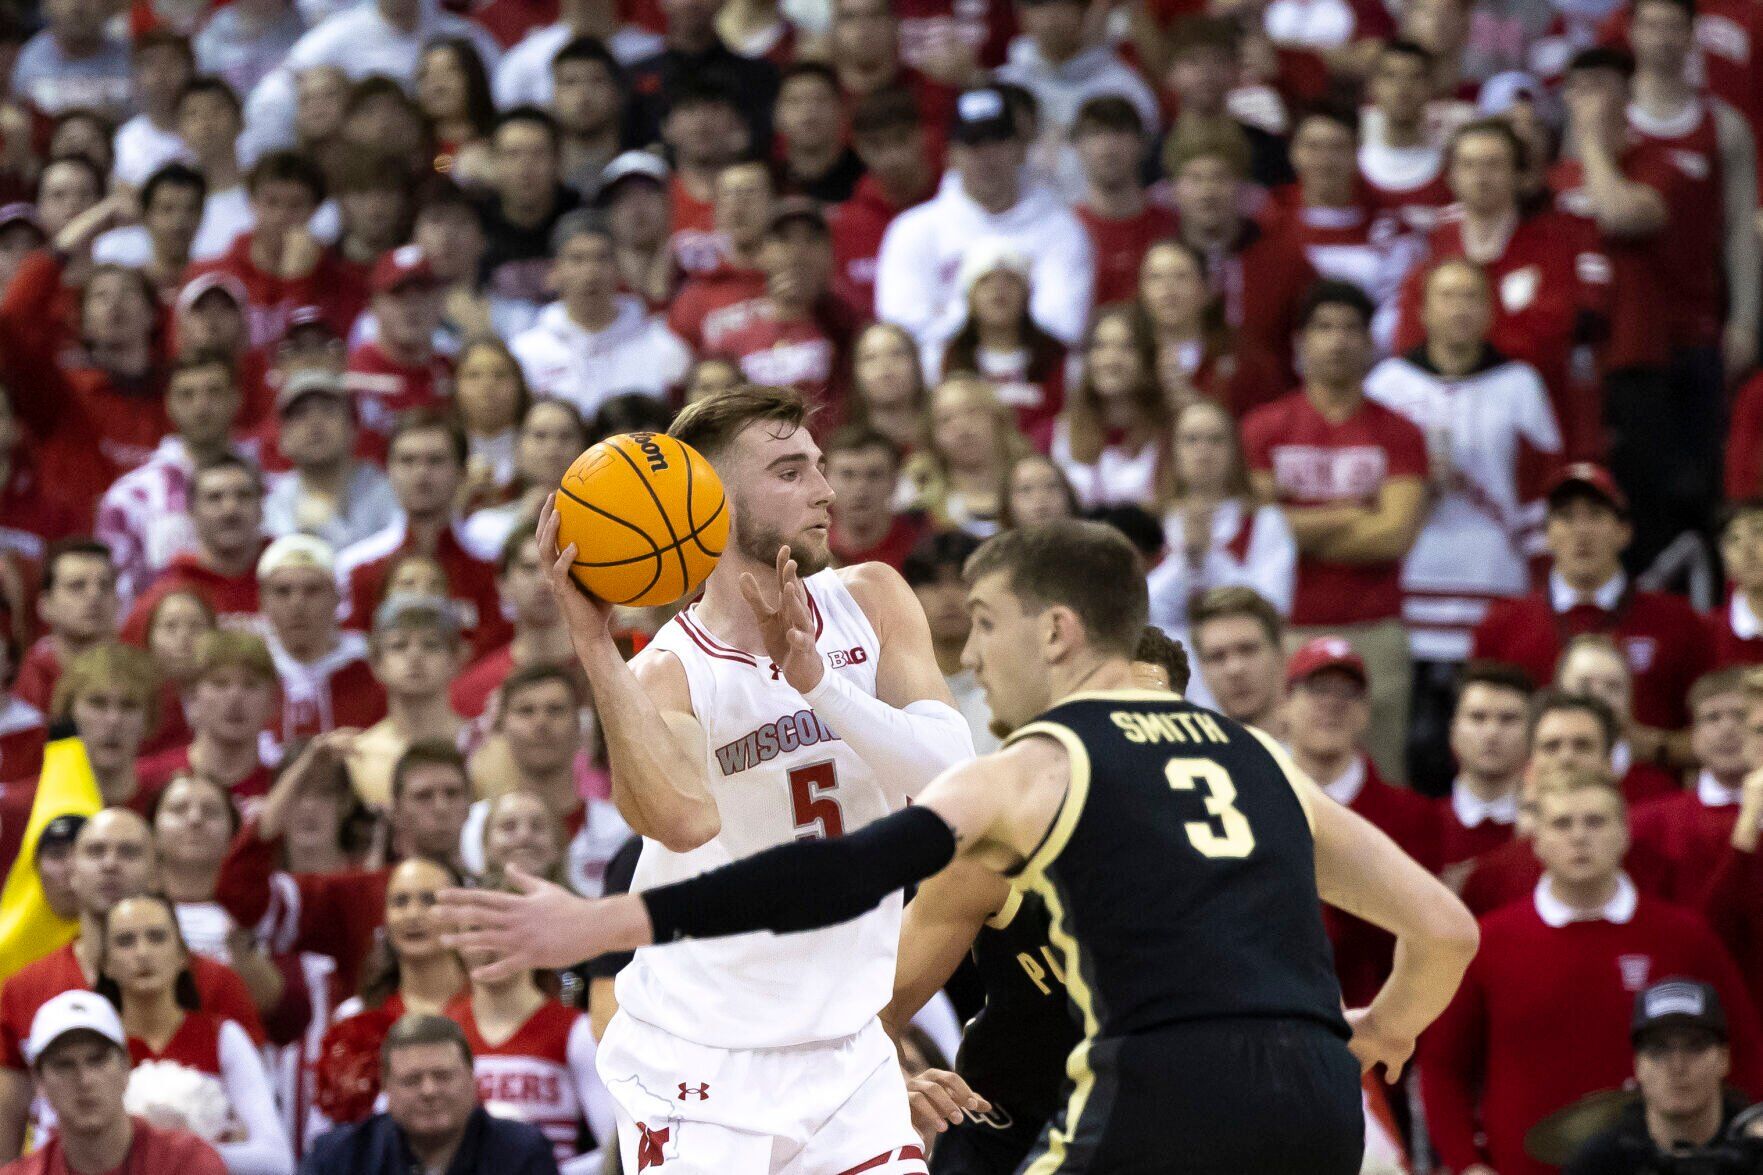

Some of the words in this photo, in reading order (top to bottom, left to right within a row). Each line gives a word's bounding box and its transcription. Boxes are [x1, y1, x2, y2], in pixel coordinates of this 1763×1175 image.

[827, 646, 867, 669] BIG
[1110, 711, 1230, 744] SMITH
[786, 758, 845, 840] 5
[1164, 757, 1256, 859] 3
